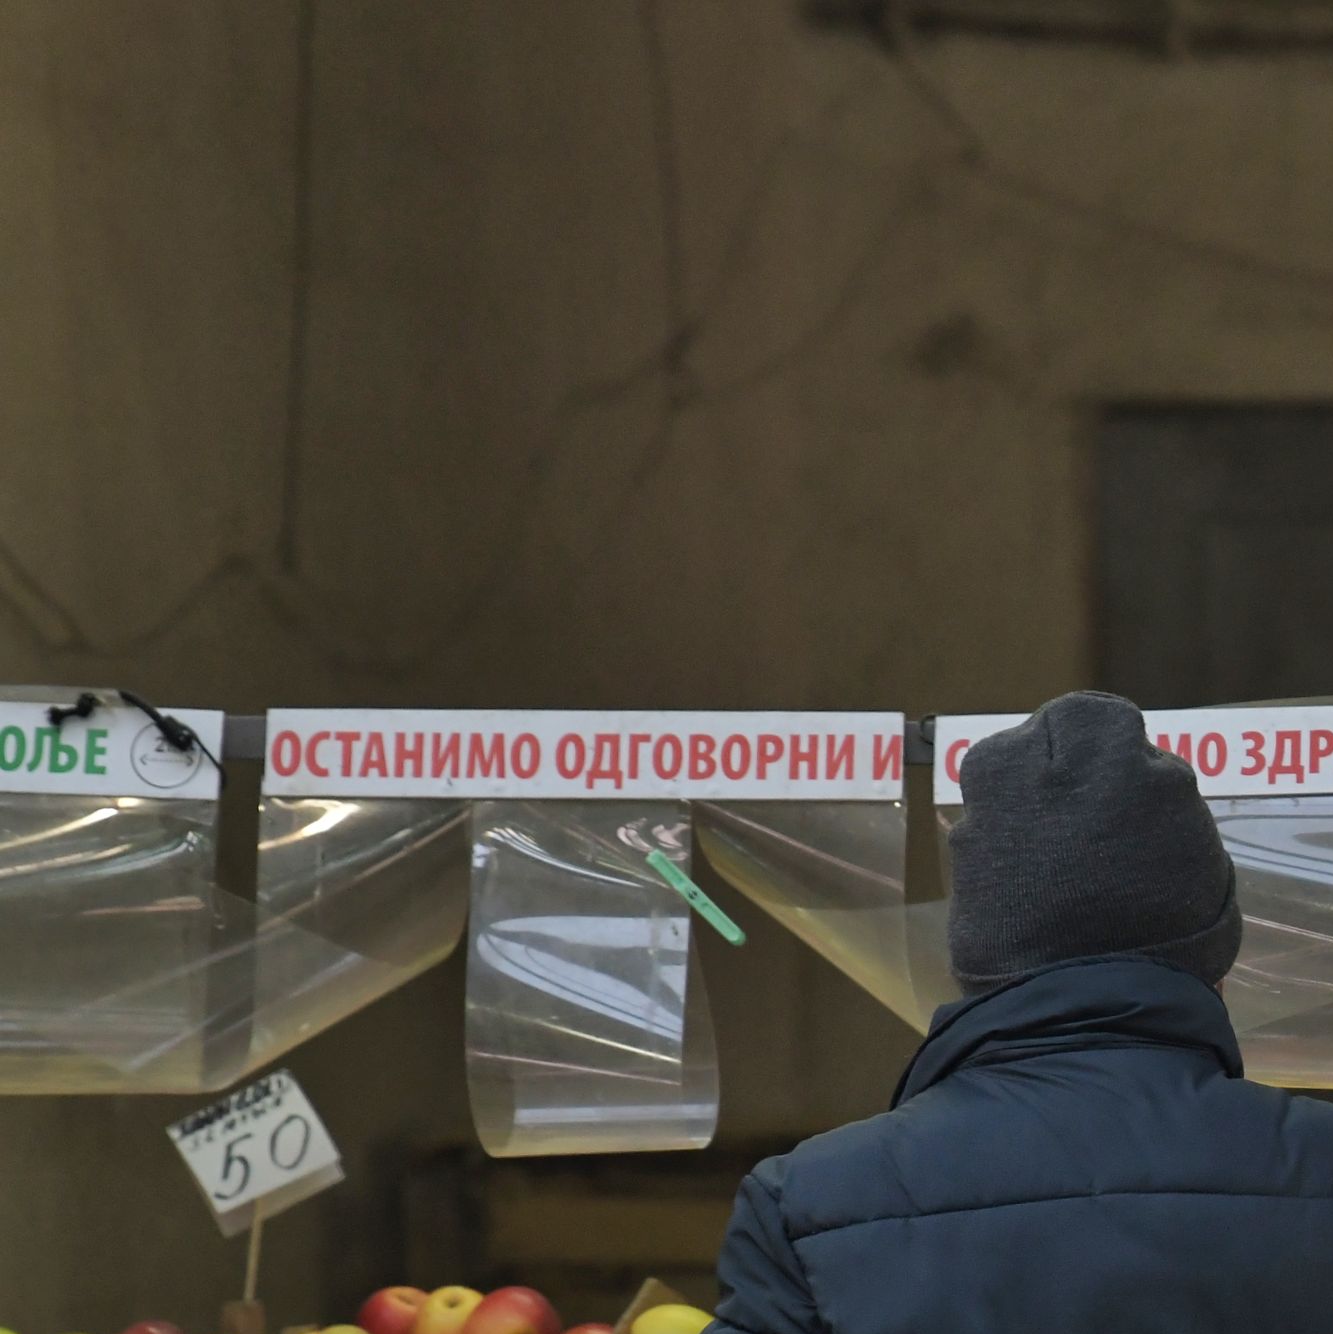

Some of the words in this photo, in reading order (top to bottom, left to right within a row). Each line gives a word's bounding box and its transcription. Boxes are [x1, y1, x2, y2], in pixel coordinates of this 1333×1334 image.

[271, 730, 541, 779] ОСТАНИМО
[555, 733, 854, 790] ОДГОВОРНИ
[872, 735, 901, 782] И
[215, 1114, 310, 1200] 50
